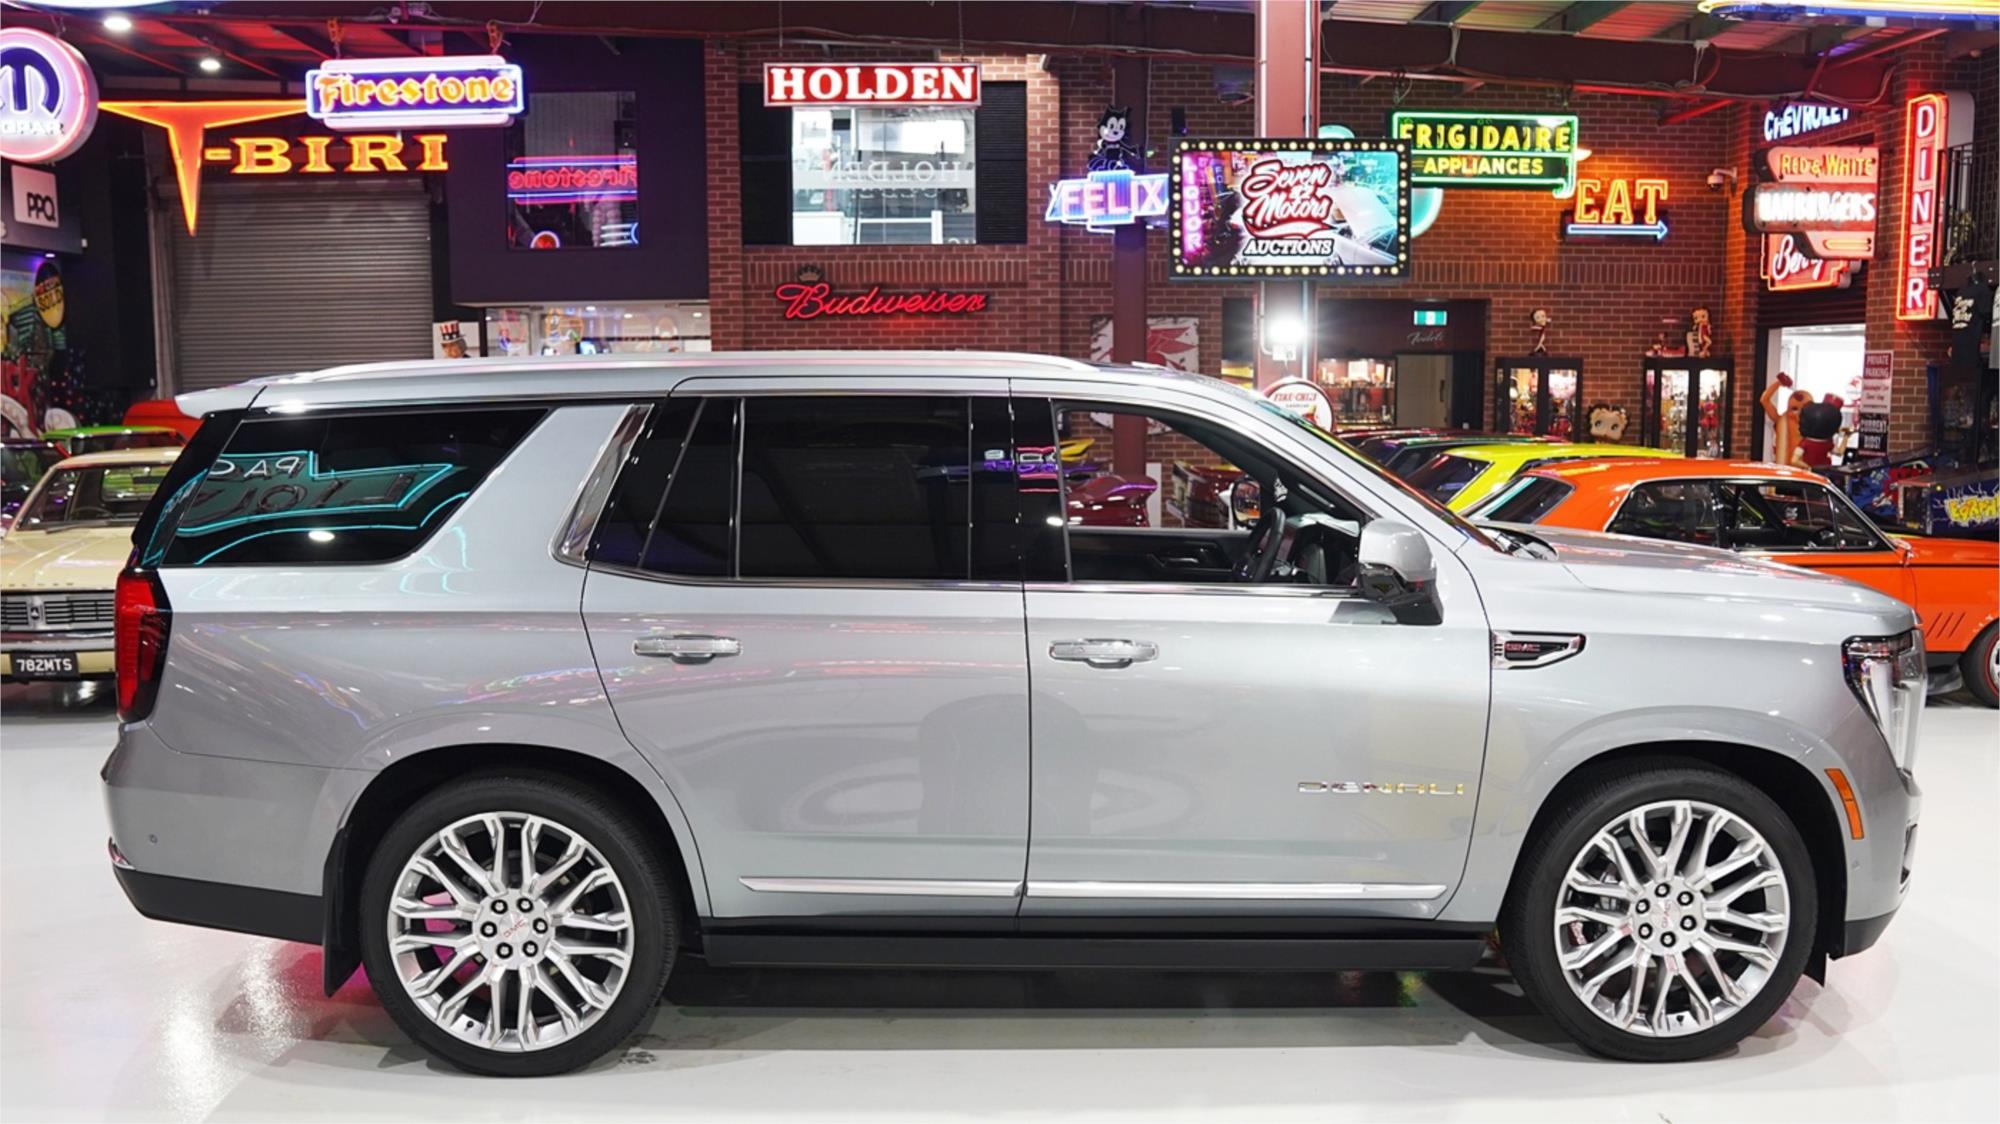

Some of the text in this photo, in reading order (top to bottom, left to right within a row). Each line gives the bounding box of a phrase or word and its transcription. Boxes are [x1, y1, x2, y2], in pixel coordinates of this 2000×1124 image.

[315, 73, 515, 113] Firestone
[770, 67, 975, 99] HOLDEN
[1400, 123, 1571, 152] FRIGIDAIRE
[1243, 161, 1330, 196] Seven
[1423, 157, 1544, 175] APPLIANCES
[1781, 154, 1808, 176] RED
[1823, 155, 1873, 176] WHITE
[27, 191, 56, 222] PPQ
[1060, 180, 1164, 215] FELIX
[1183, 155, 1203, 252] LIQUOR
[1246, 190, 1331, 227] Motors
[1575, 179, 1668, 224] EAT
[1759, 192, 1876, 222] HAMBURGERS
[1906, 104, 1935, 309] DINER
[1244, 239, 1334, 256] AUCTIONS
[776, 283, 986, 319] Budweiser
[16, 658, 73, 672] 782MTS
[1298, 781, 1464, 795] DENALI
